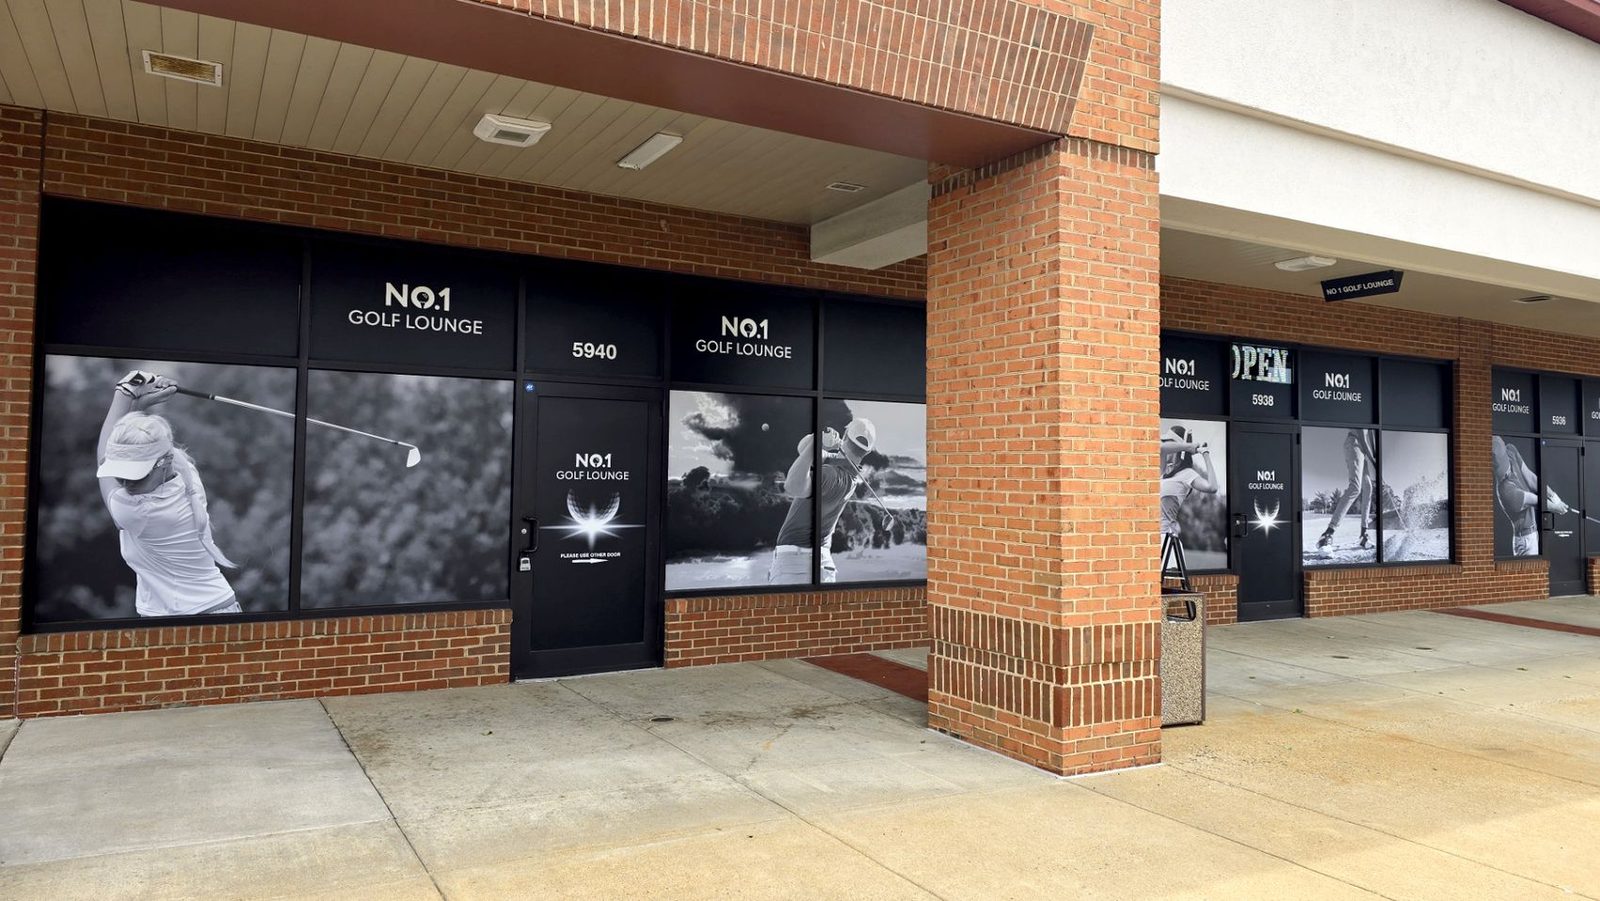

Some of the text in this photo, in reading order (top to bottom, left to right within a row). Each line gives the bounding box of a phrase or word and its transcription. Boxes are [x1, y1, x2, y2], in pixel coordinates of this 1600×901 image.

[1326, 287, 1337, 295] NO
[1343, 284, 1362, 293] GOLF
[1363, 278, 1394, 289] LOUNGE
[385, 282, 450, 312] NO.1
[348, 309, 483, 335] GOLF LOUNGE
[721, 315, 768, 339] NO.1
[572, 342, 617, 360] 5940
[696, 339, 792, 359] GOLF LOUNGE
[1165, 357, 1195, 376] NO.1
[1159, 377, 1210, 391] OLF LOUNGE
[1325, 372, 1350, 389] NO.1
[1252, 394, 1274, 407] 5938
[1312, 389, 1362, 402] GOLF LOUNGE
[1492, 403, 1530, 415] GOLF LOUNGE
[575, 453, 612, 468] NO.1
[556, 470, 630, 480] GOLF LOUNGE
[1248, 482, 1284, 490] GOLF LOUNGE
